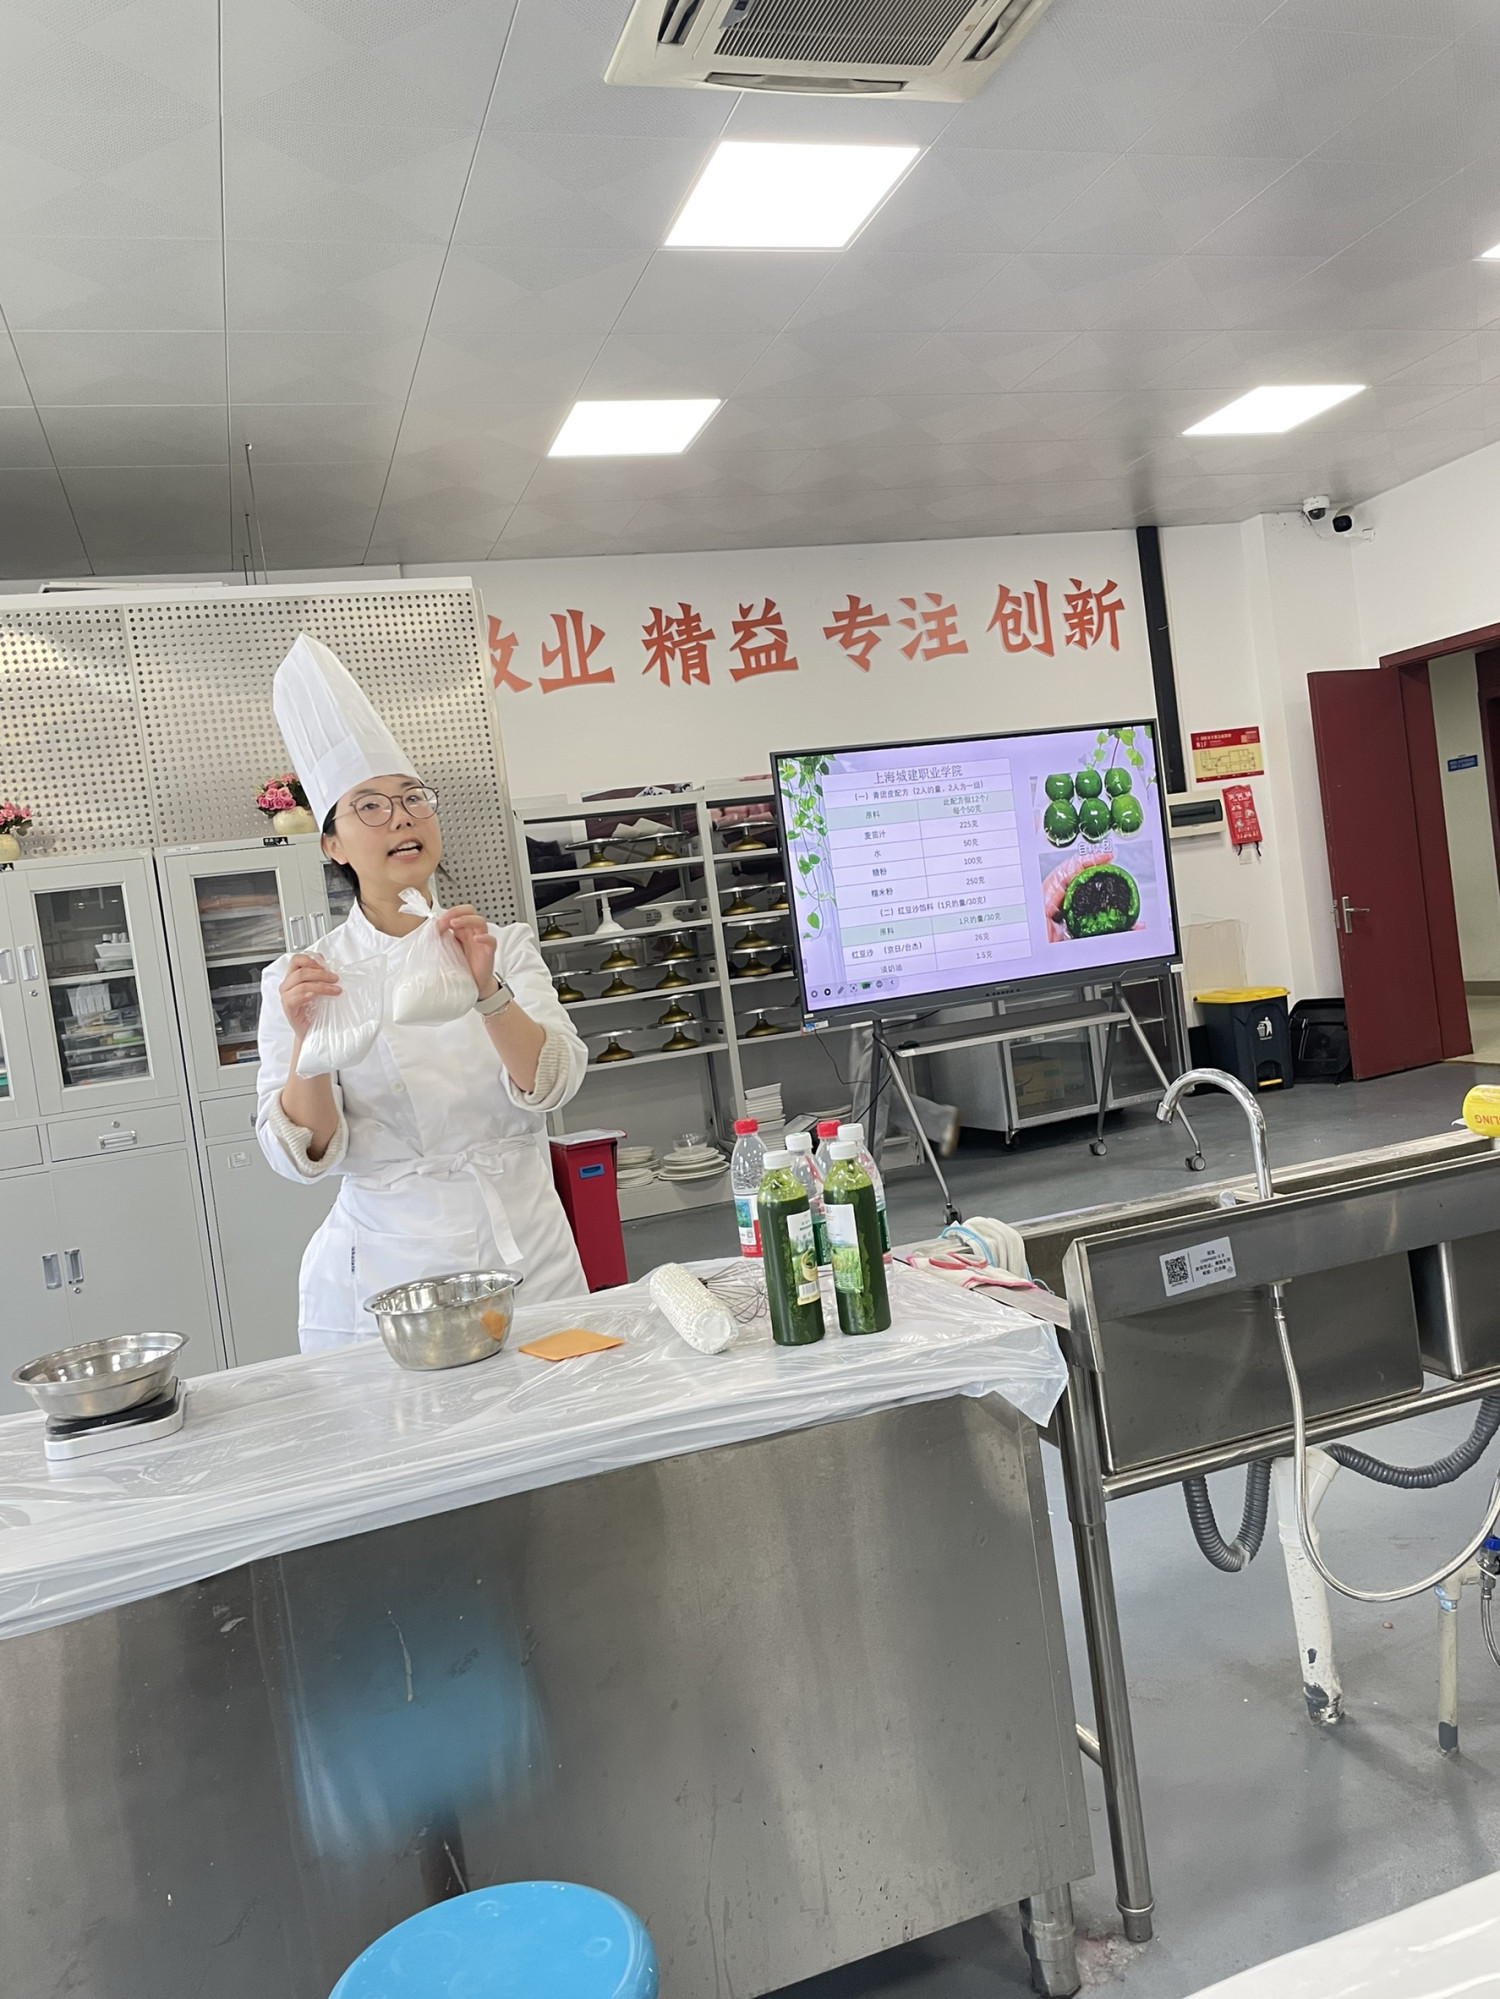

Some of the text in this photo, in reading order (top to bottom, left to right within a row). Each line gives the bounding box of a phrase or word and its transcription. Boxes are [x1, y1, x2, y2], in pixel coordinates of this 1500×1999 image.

[641, 598, 799, 687] 精益
[823, 591, 969, 673] 专注
[985, 578, 1126, 658] 创新
[874, 765, 963, 785] 上海城建职业学院
[865, 810, 880, 820] 原料
[959, 819, 979, 829] 225克
[963, 838, 980, 847] 50克
[874, 849, 882, 858] 水
[963, 856, 983, 866] 100克
[872, 867, 887, 877] 糖粉
[966, 876, 985, 886] 250克
[871, 887, 893, 898] 糯米粉
[959, 912, 1001, 925] 1只的量/30克
[880, 927, 895, 936] 原料
[974, 932, 990, 942] 26克
[851, 948, 874, 959] 红豆沙
[976, 950, 993, 960] 1.5克
[880, 963, 903, 974] 淡奶油
